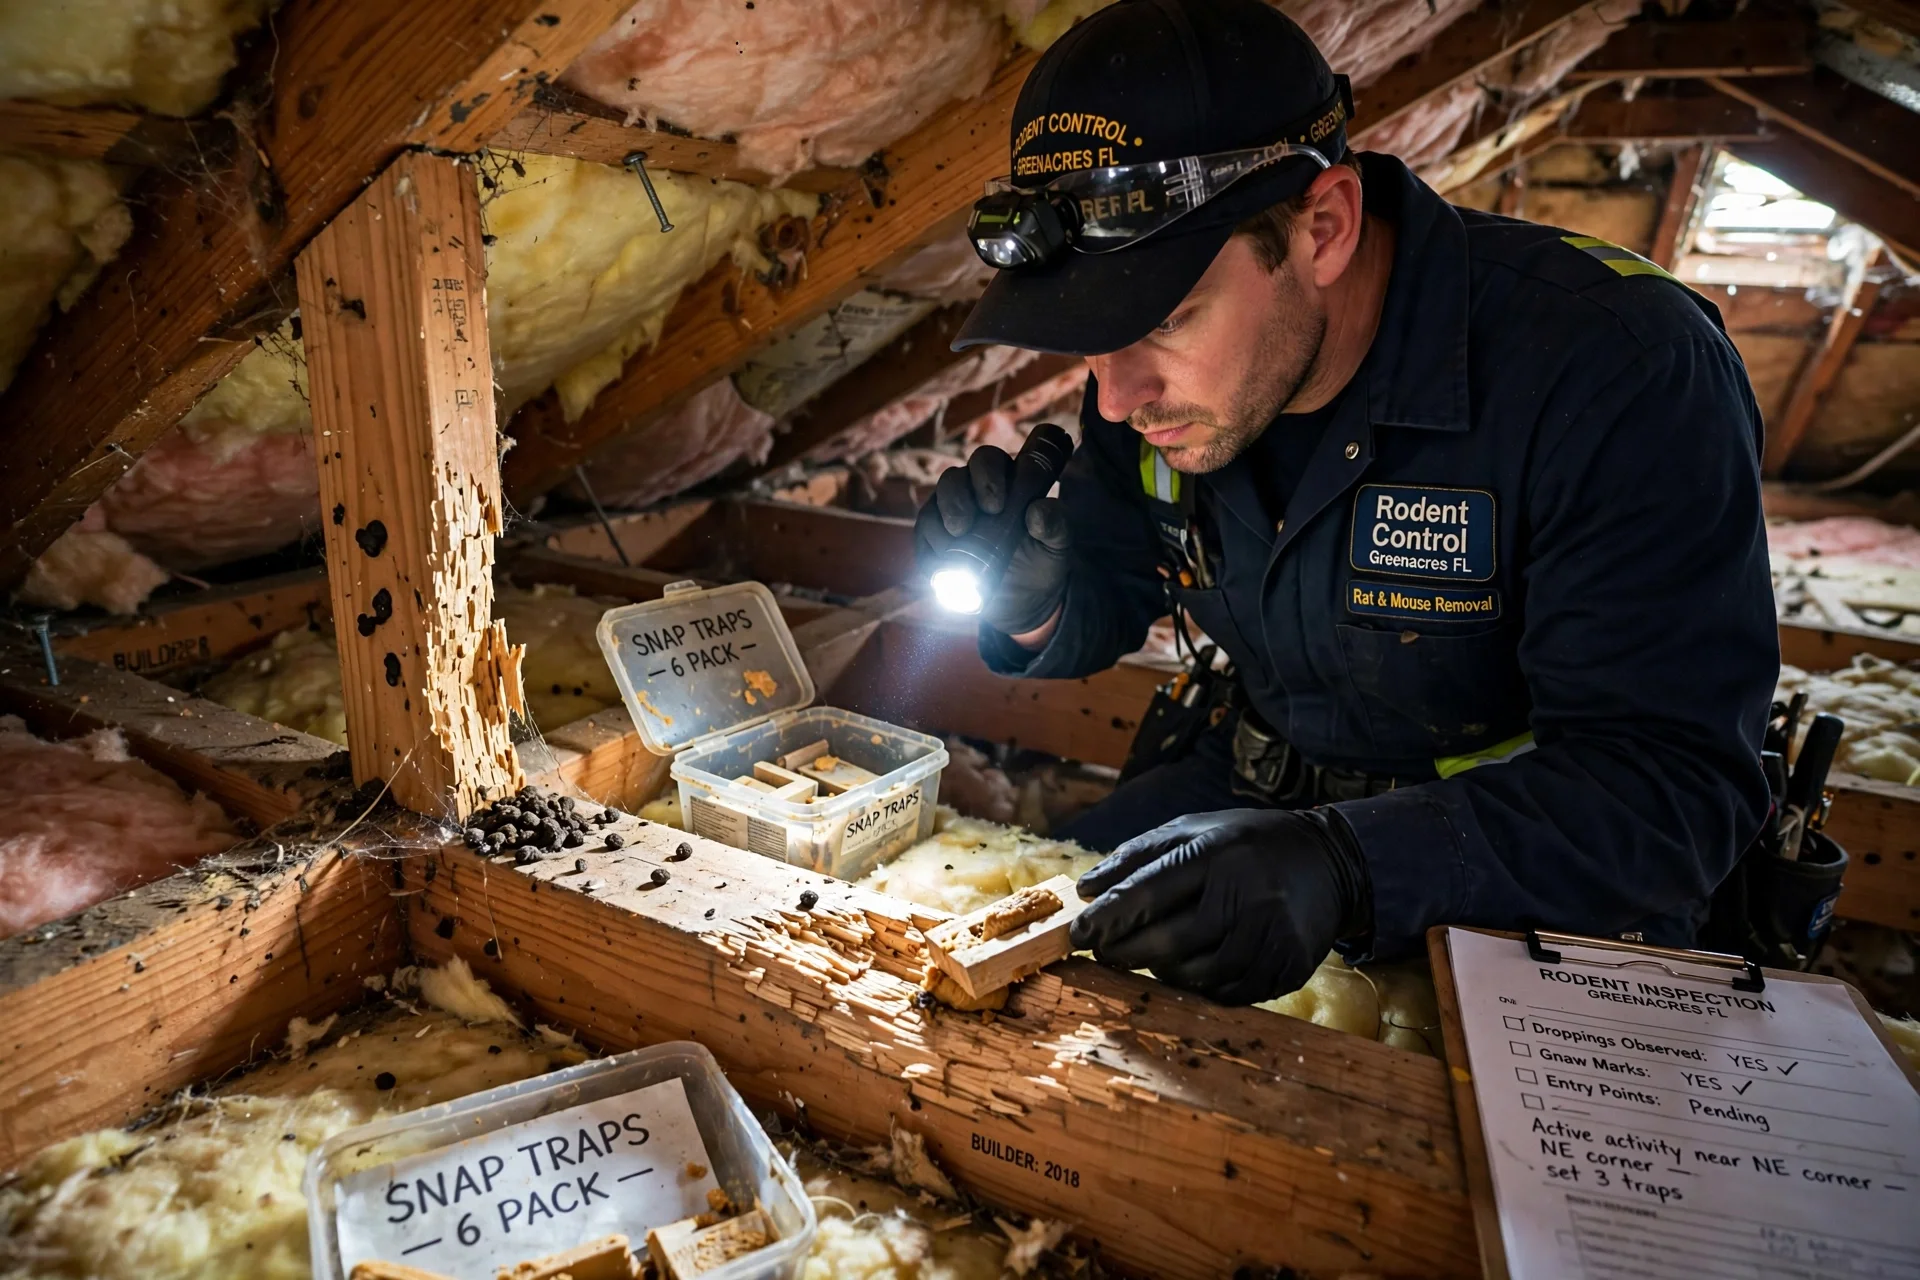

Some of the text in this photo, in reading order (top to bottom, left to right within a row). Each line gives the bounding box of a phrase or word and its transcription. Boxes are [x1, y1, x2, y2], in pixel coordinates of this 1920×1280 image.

[1048, 112, 1127, 146] CONTROL
[1017, 146, 1119, 176] GREENACRES FL
[1376, 494, 1469, 525] Rodent
[1372, 522, 1467, 554] Control
[1369, 549, 1472, 573] Greenacres FL
[1353, 588, 1493, 613] Rat & Mouse Removal
[632, 609, 753, 656] SNAP TRAPS
[671, 657, 685, 677] 6
[686, 642, 740, 672] PACK
[846, 811, 880, 838] SNAP
[883, 789, 919, 819] TRAPS
[1539, 967, 1776, 1013] RODENT INSPECTION
[1587, 989, 1728, 1019] GREENACRES FL
[1532, 1022, 1707, 1062] Droppings Observed:
[1539, 1048, 1651, 1078] Gnaw Marks:
[1727, 1053, 1768, 1072] YES
[1546, 1074, 1661, 1106] Entry Points:
[1681, 1071, 1722, 1091] YES
[1688, 1098, 1770, 1132] Pending
[385, 1113, 650, 1224] SNAP TRAPS
[971, 1132, 1080, 1188] BUILDER: 2018
[1532, 1117, 1594, 1142] Active
[1605, 1133, 1681, 1165] activity
[1695, 1150, 1741, 1168] near
[1752, 1156, 1790, 1177] NE
[1802, 1167, 1872, 1190] corner
[1540, 1138, 1574, 1159] NE
[1586, 1150, 1653, 1172] corner
[1547, 1164, 1683, 1203] set 3 traps
[456, 1212, 481, 1247] 6
[497, 1171, 610, 1234] PACK
